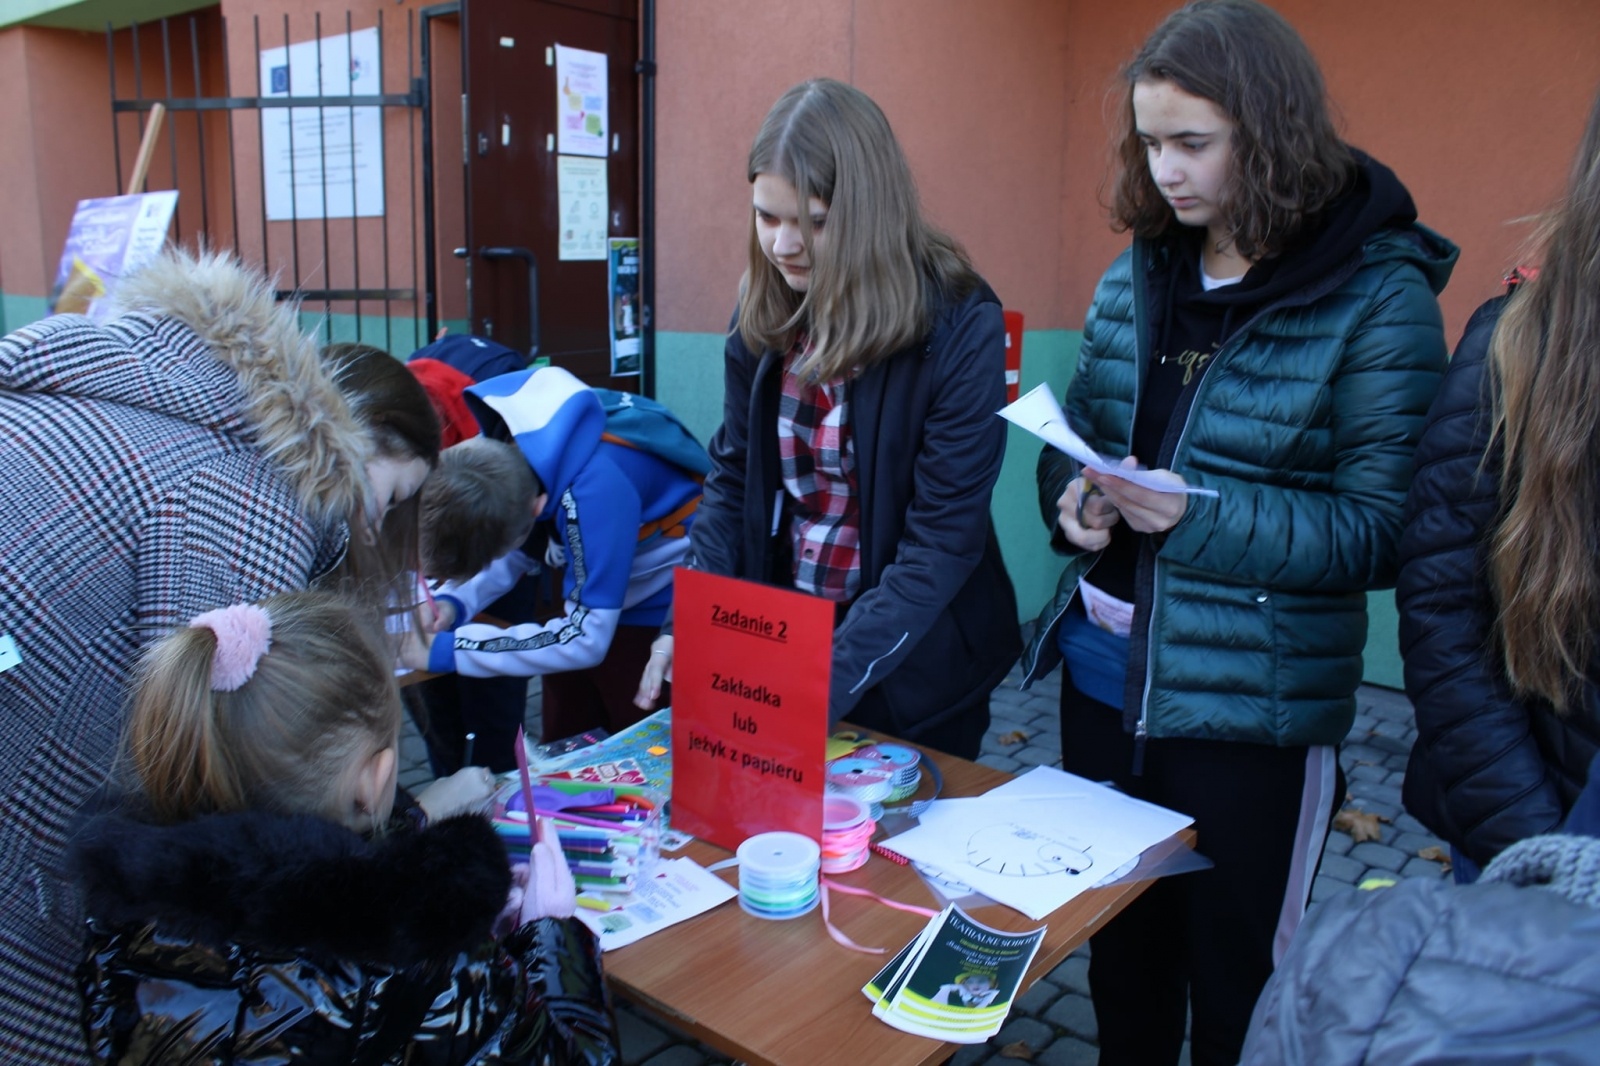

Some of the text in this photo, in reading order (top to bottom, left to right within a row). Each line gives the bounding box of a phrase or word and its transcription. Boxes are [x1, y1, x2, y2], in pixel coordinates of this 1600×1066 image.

[711, 605, 788, 639] Zadanie 2
[711, 673, 781, 708] Zakładka
[732, 712, 758, 735] lub
[688, 732, 803, 783] jeżyk z papieru
